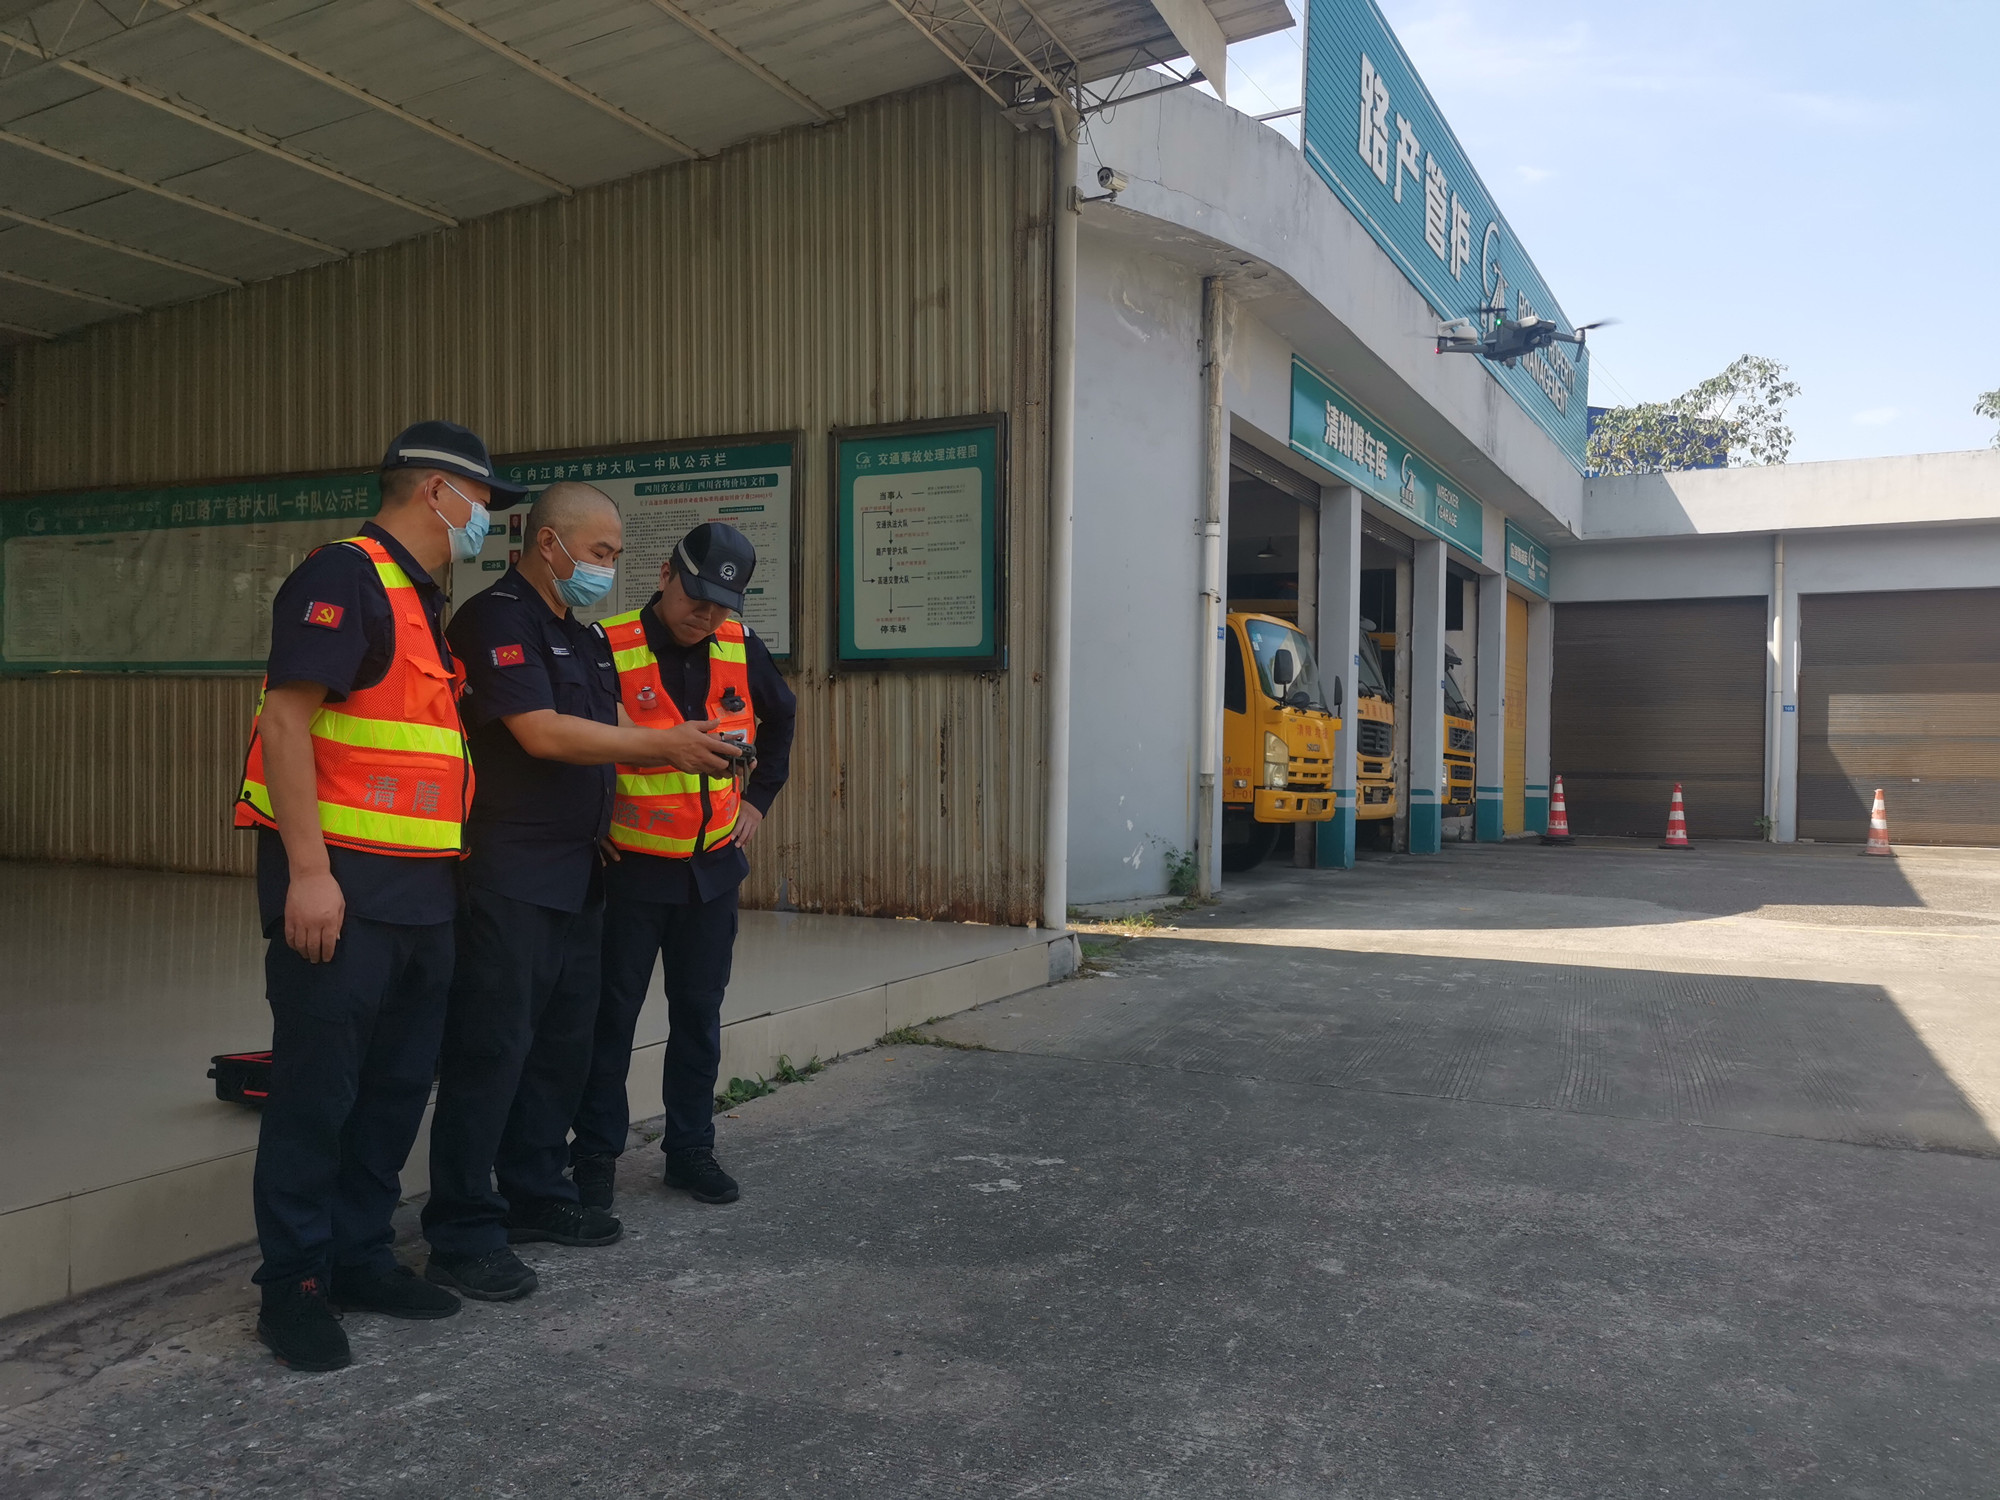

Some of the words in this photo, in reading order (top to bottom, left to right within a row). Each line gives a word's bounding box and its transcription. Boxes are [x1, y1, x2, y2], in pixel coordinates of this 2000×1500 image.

[1358, 52, 1471, 282] 路产管护
[1544, 340, 1577, 396] ROPERTY
[1324, 399, 1388, 480] 清排障车库
[526, 452, 728, 481] 内江路产管护大队一中队公示栏
[877, 444, 978, 466] 交通事故处理流程图
[644, 481, 692, 493] 四川省交通厅
[750, 476, 766, 487] 文件
[879, 491, 903, 501] 当事人
[171, 486, 370, 523] 内江路产管护大队一中队公示栏
[880, 624, 907, 634] 停车场
[363, 773, 442, 815] 清障
[614, 800, 675, 830] 路产
